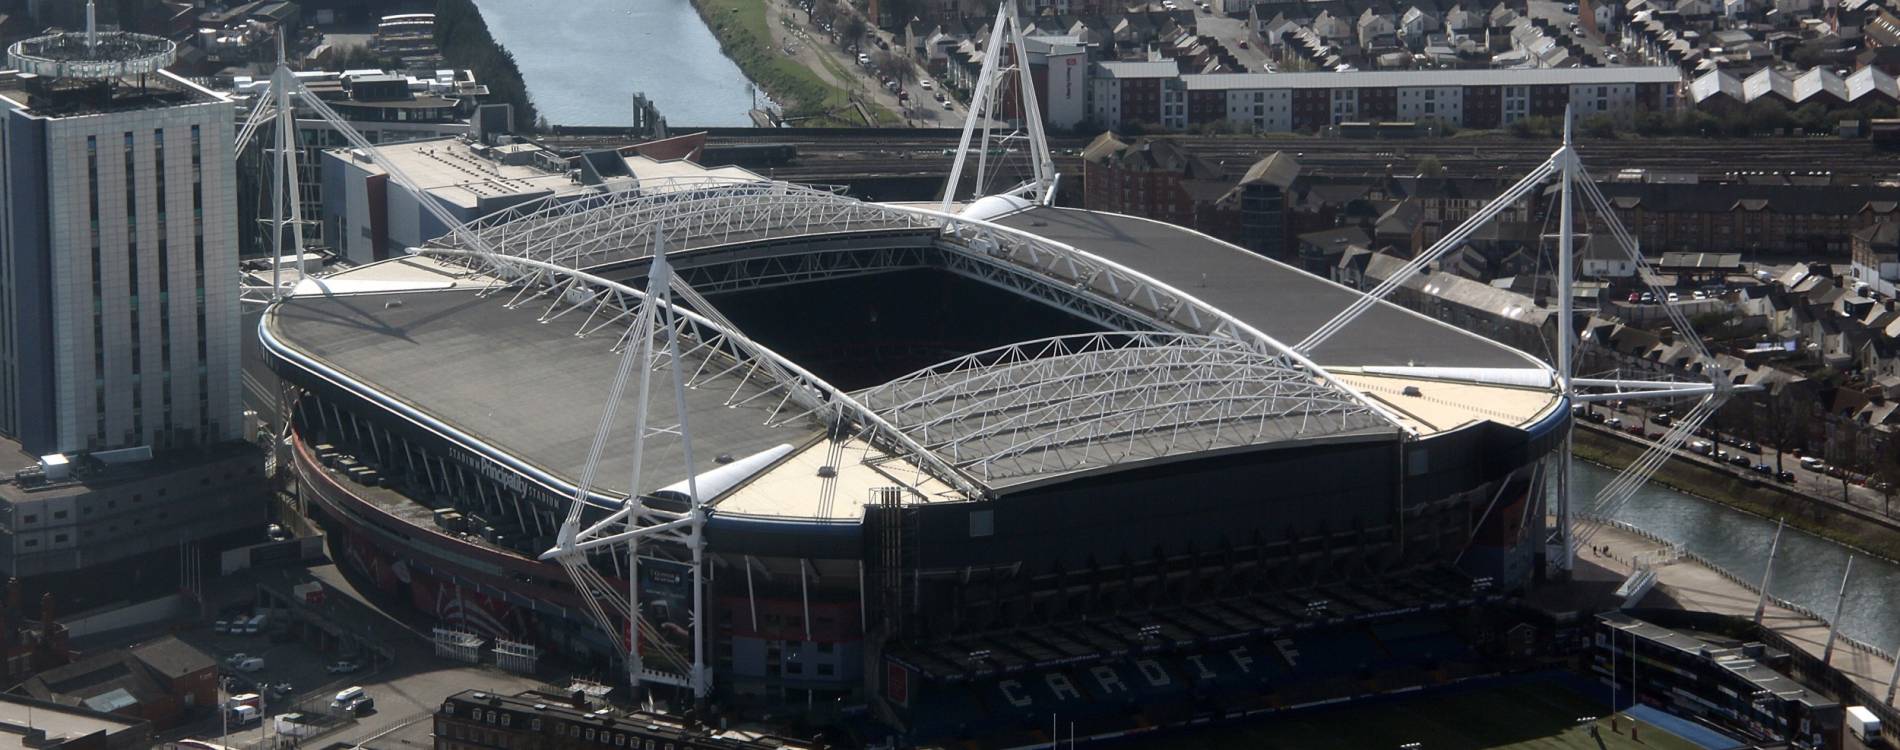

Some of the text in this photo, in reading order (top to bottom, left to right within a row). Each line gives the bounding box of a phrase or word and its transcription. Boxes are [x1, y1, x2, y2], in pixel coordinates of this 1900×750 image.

[448, 447, 560, 509] STADIWM Principality STADIUM
[999, 638, 1301, 707] CARDIFF
